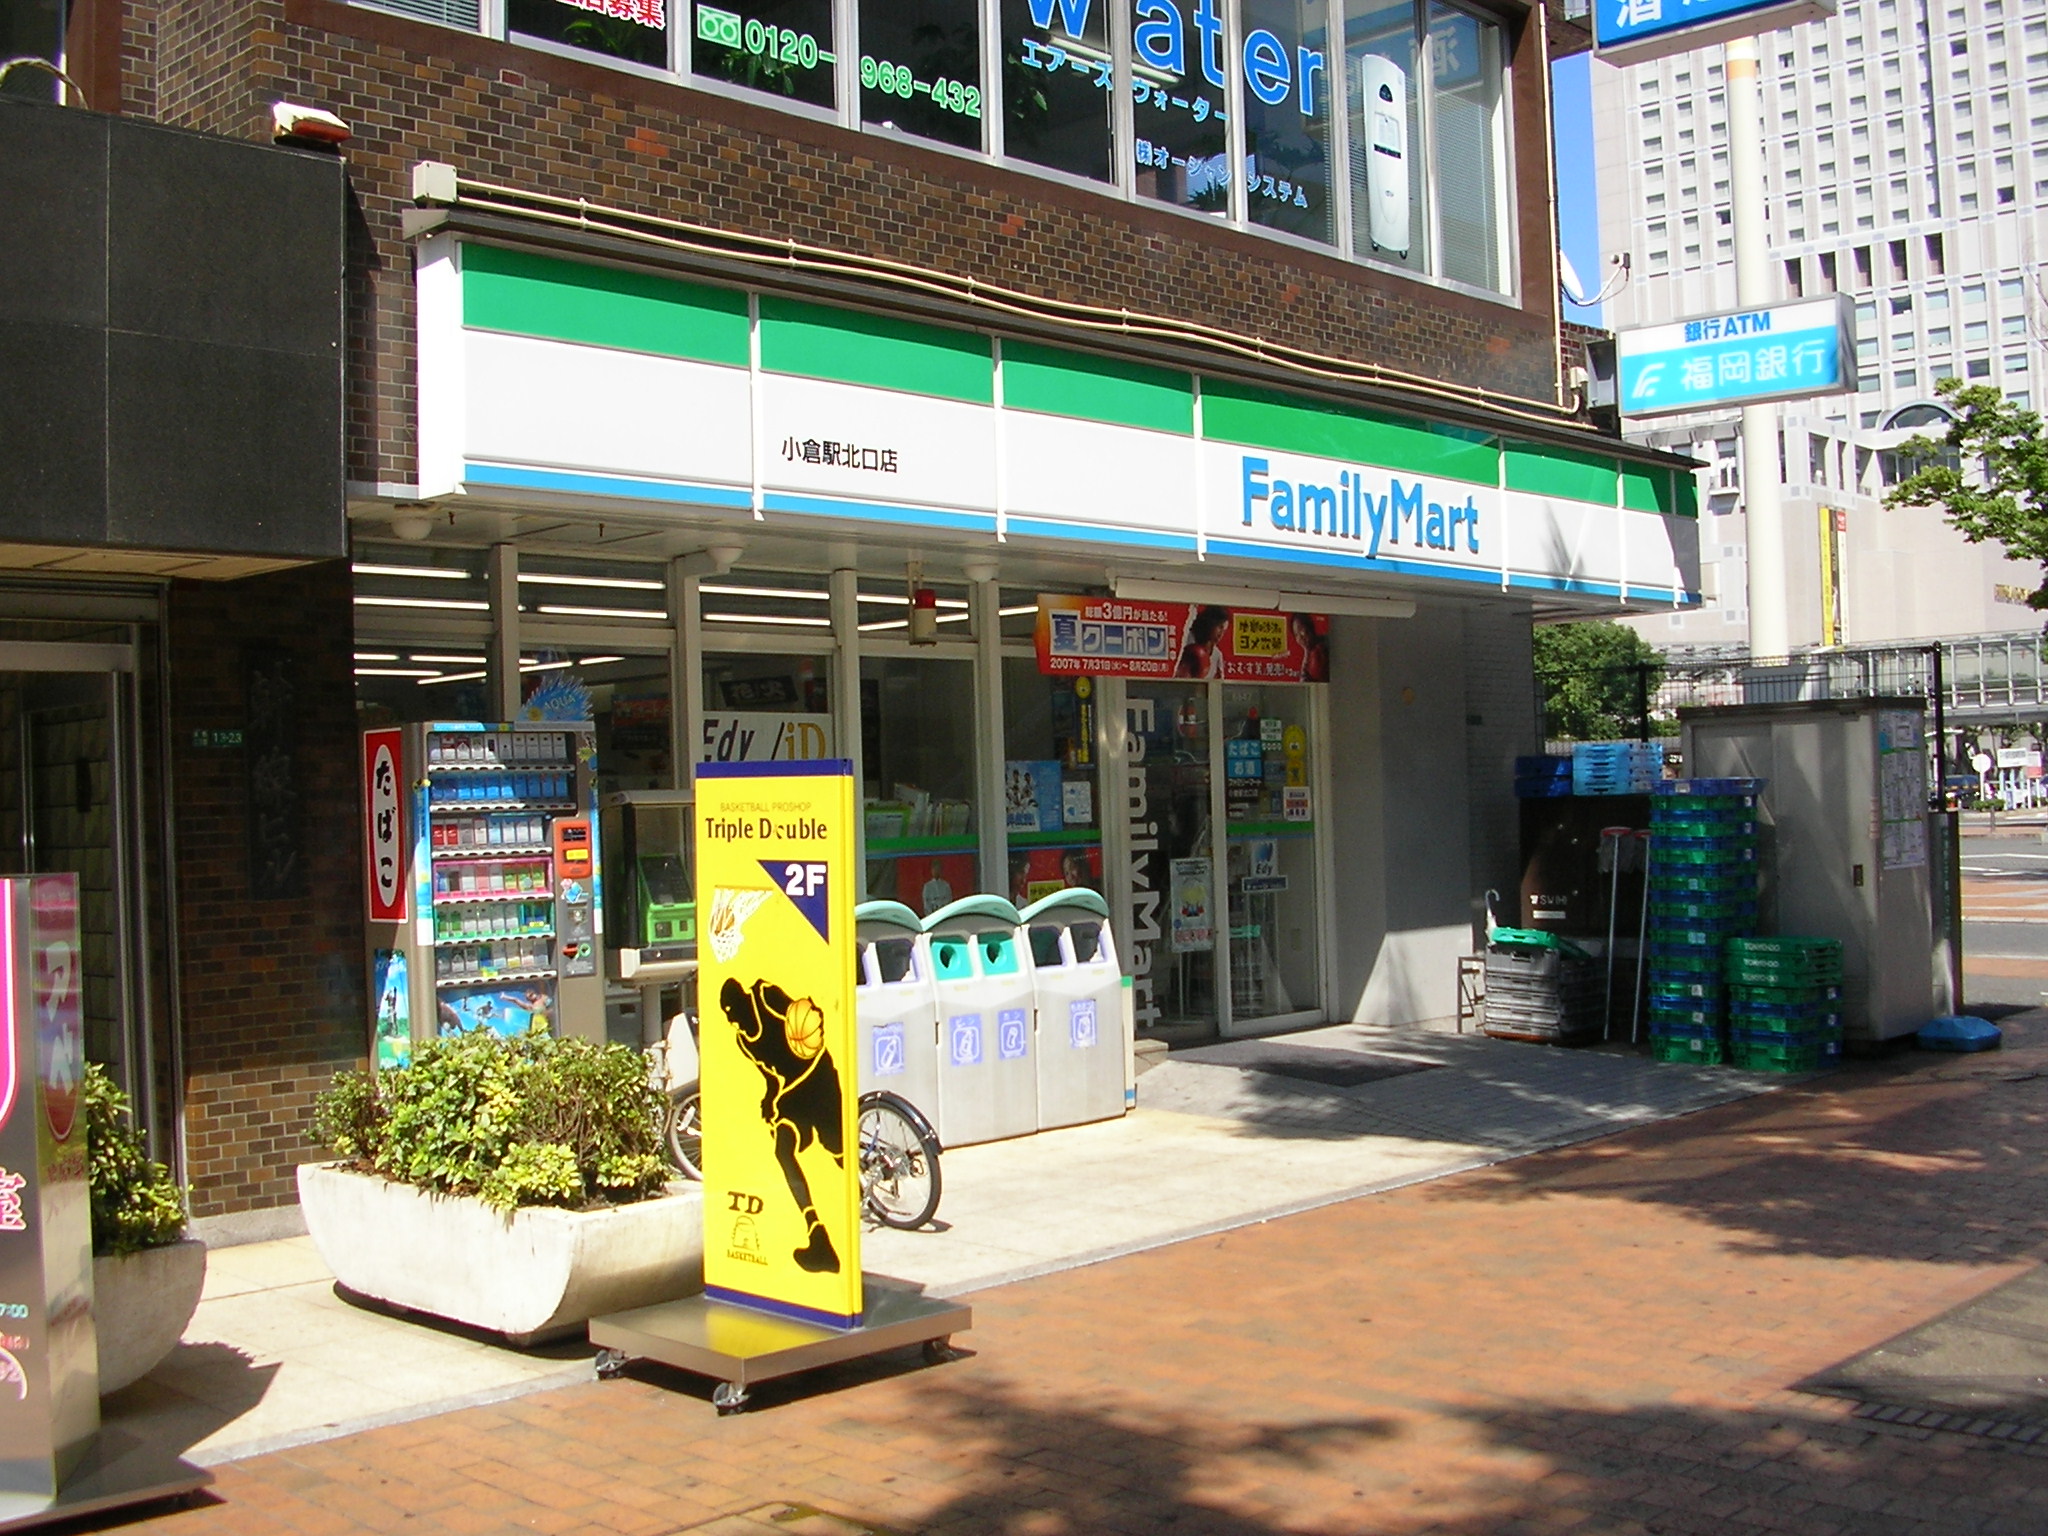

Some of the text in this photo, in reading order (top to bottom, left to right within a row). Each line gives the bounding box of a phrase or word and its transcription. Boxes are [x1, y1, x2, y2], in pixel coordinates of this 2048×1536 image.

[1684, 310, 1771, 343] 銀行ATM
[1680, 339, 1826, 391] 福岡銀行
[781, 436, 898, 474] 小倉駅北口店
[1242, 455, 1480, 560] FamilyMart
[1050, 612, 1168, 659] 夏クーポン
[720, 801, 811, 813] BASKETBALL PROSHOP
[375, 760, 397, 888] たばこ
[705, 817, 753, 843] Triple
[785, 863, 827, 896] 2F
[727, 1190, 764, 1215] TD
[727, 1249, 769, 1266] BASKETBALL
